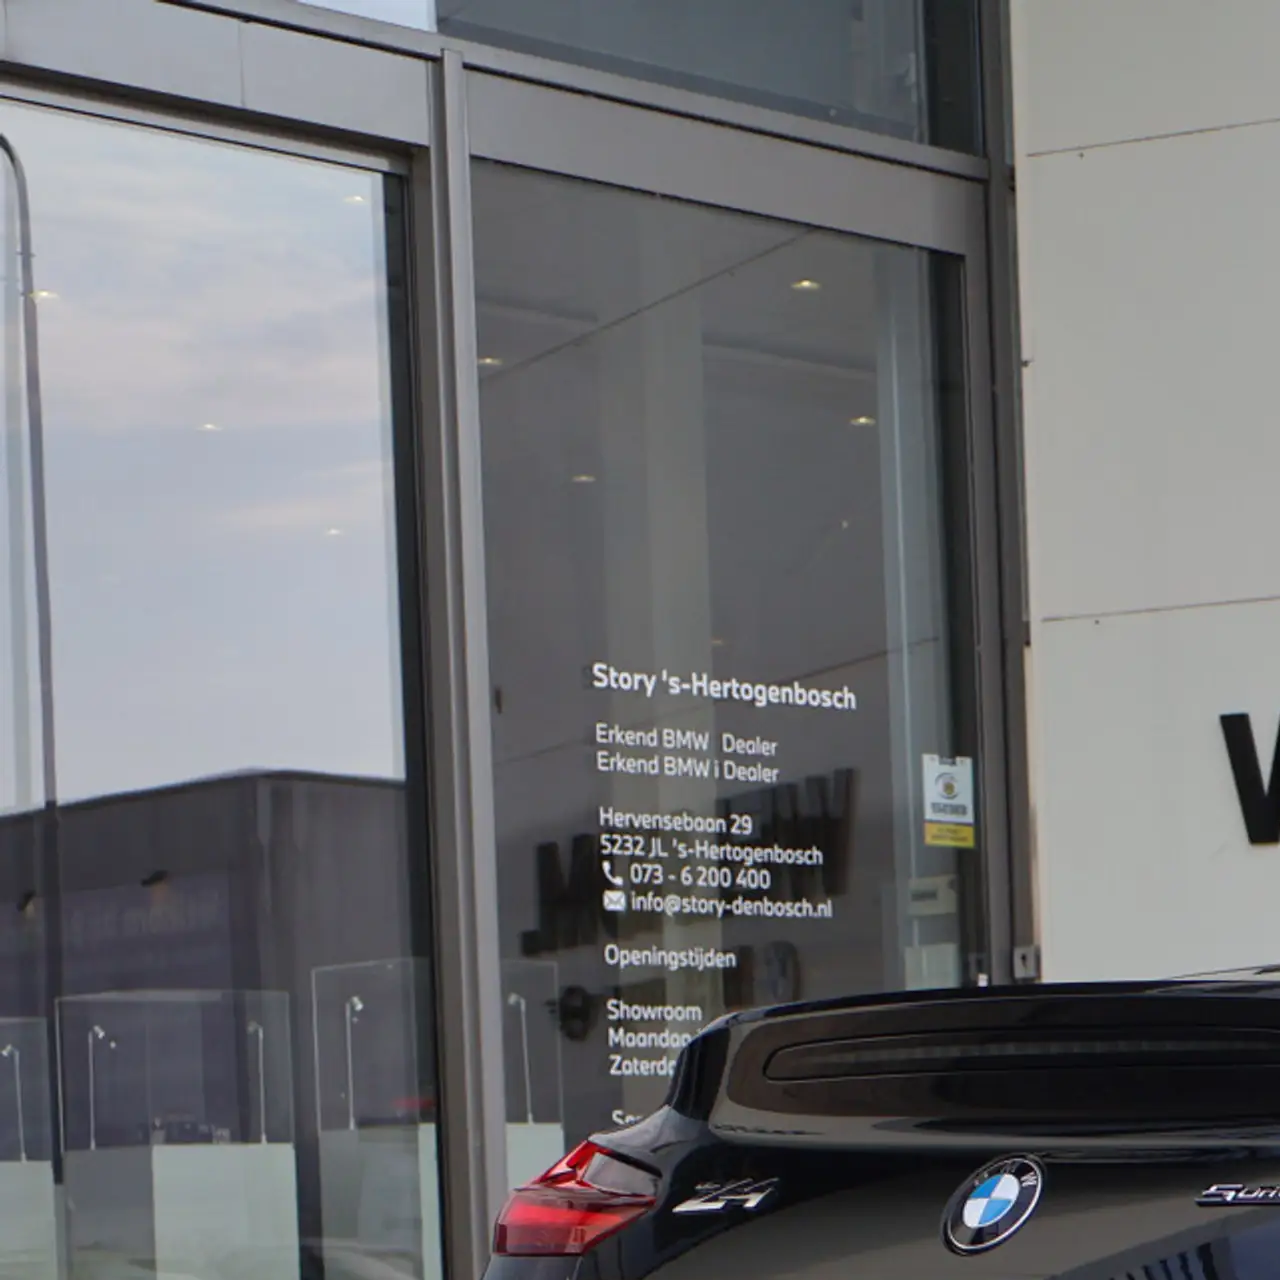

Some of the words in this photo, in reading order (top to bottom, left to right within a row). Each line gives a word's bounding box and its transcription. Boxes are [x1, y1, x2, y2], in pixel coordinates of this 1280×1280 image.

[592, 662, 657, 698] Story
[661, 669, 857, 710] 's-Hertogenbosch
[596, 723, 658, 748] Erkend
[662, 728, 709, 751] BMW
[722, 733, 778, 756] Dealer
[597, 751, 659, 775] Erkend
[664, 756, 711, 778] BMW
[713, 759, 719, 779] i
[724, 761, 780, 783] Dealer
[599, 806, 727, 834] Hervensebaan
[730, 814, 753, 835] 29
[600, 834, 645, 856] 5232
[648, 838, 668, 859] JL
[672, 838, 824, 866] 's-Hertogenbosch
[630, 863, 663, 884] 073
[680, 867, 692, 886] 6
[696, 867, 731, 887] 200
[736, 869, 771, 889] 400
[631, 891, 833, 918] info@story-denbosch.nl
[604, 943, 736, 970] Openingstijden
[606, 998, 703, 1020] Showroom
